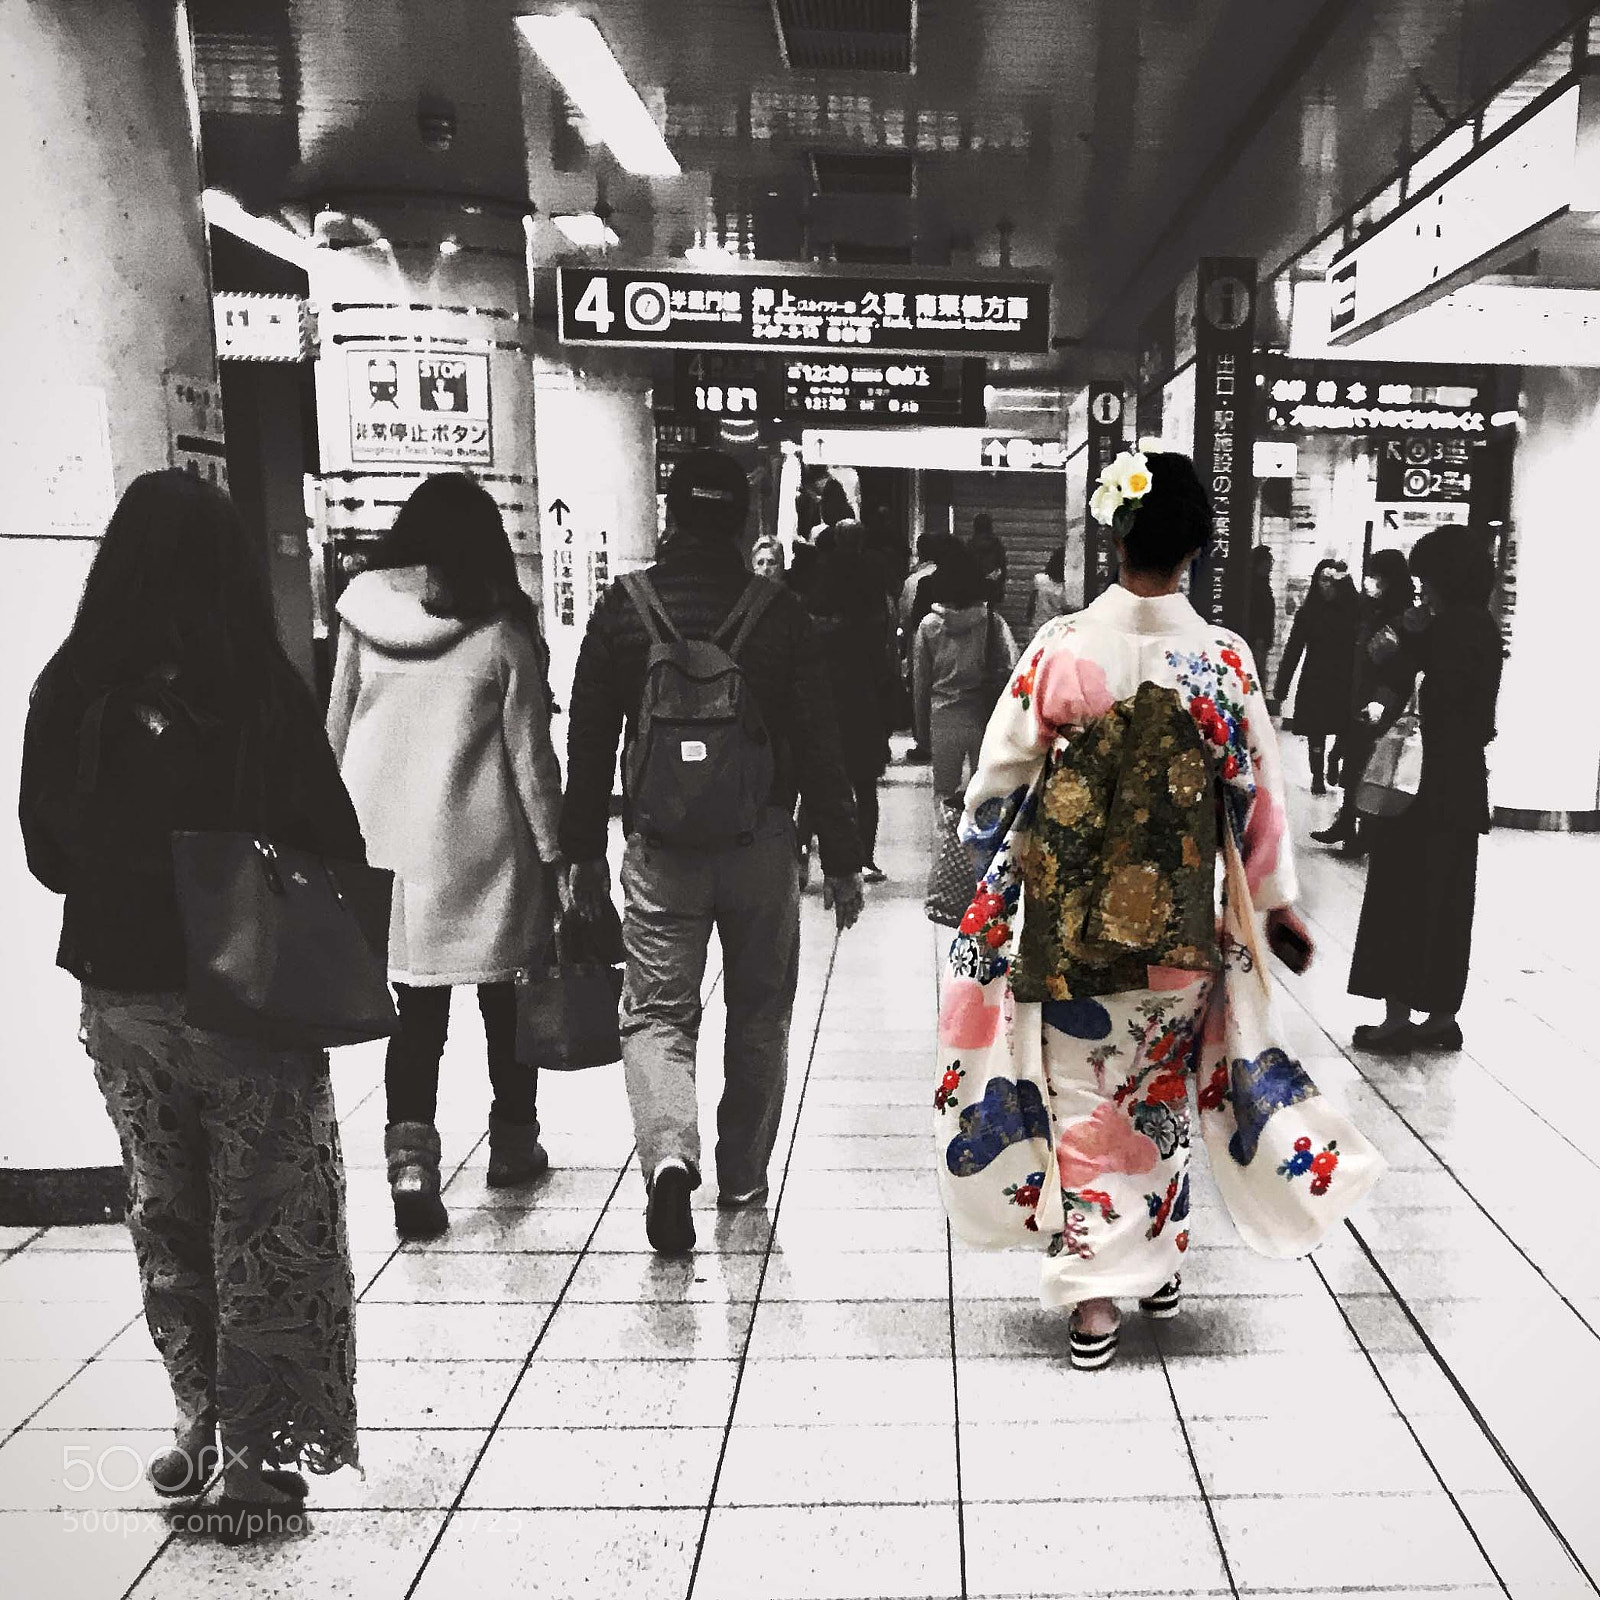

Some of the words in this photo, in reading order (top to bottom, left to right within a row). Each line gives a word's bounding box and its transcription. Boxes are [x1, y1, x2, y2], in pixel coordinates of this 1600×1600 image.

[574, 276, 615, 334] 4
[419, 360, 466, 379] STOP
[564, 529, 574, 545] 2
[600, 531, 608, 545] 1
